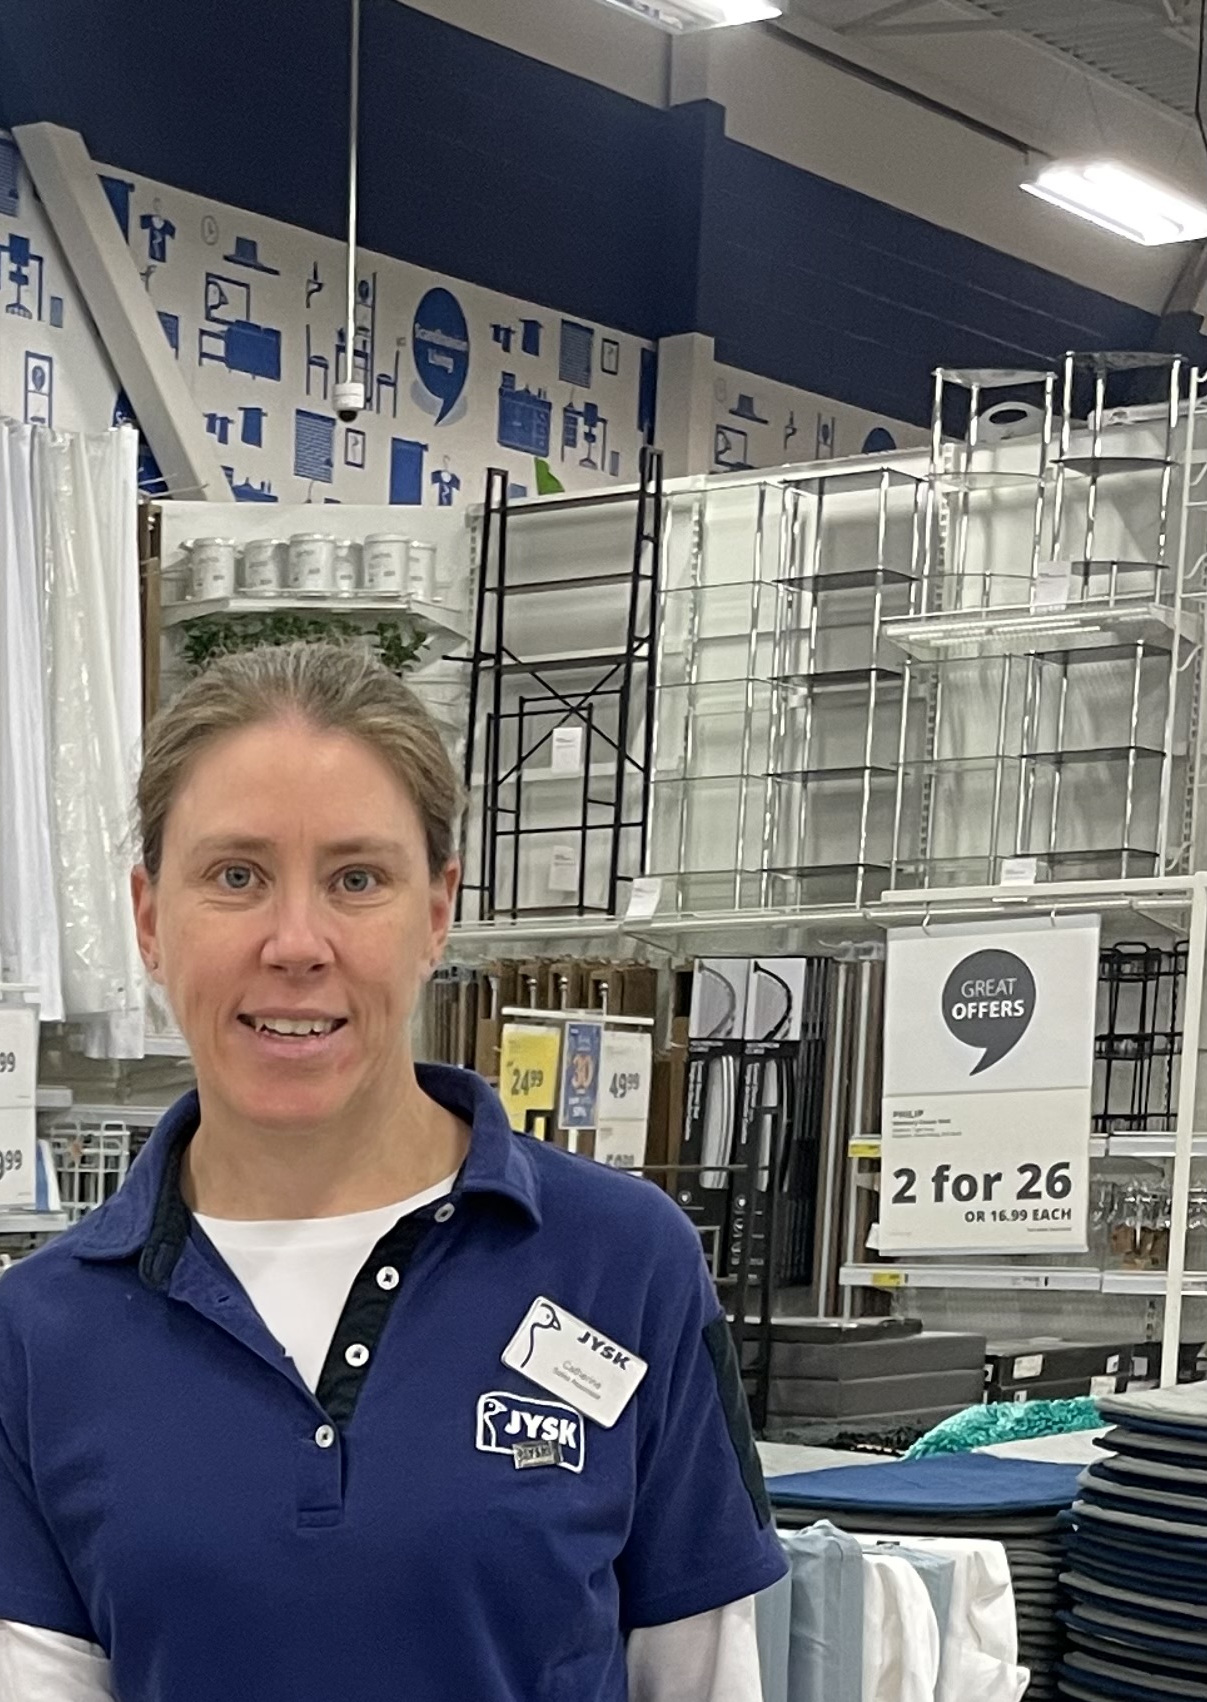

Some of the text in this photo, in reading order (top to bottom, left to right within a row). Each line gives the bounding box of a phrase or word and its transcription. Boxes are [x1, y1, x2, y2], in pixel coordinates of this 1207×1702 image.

[961, 977, 1017, 999] GREAT
[951, 999, 1025, 1021] OFFERS
[892, 1161, 1073, 1205] 2 for 26
[964, 1207, 1072, 1223] OR 16.99 EACH
[577, 1330, 632, 1371] JYSK
[504, 1410, 578, 1450] JYSK
